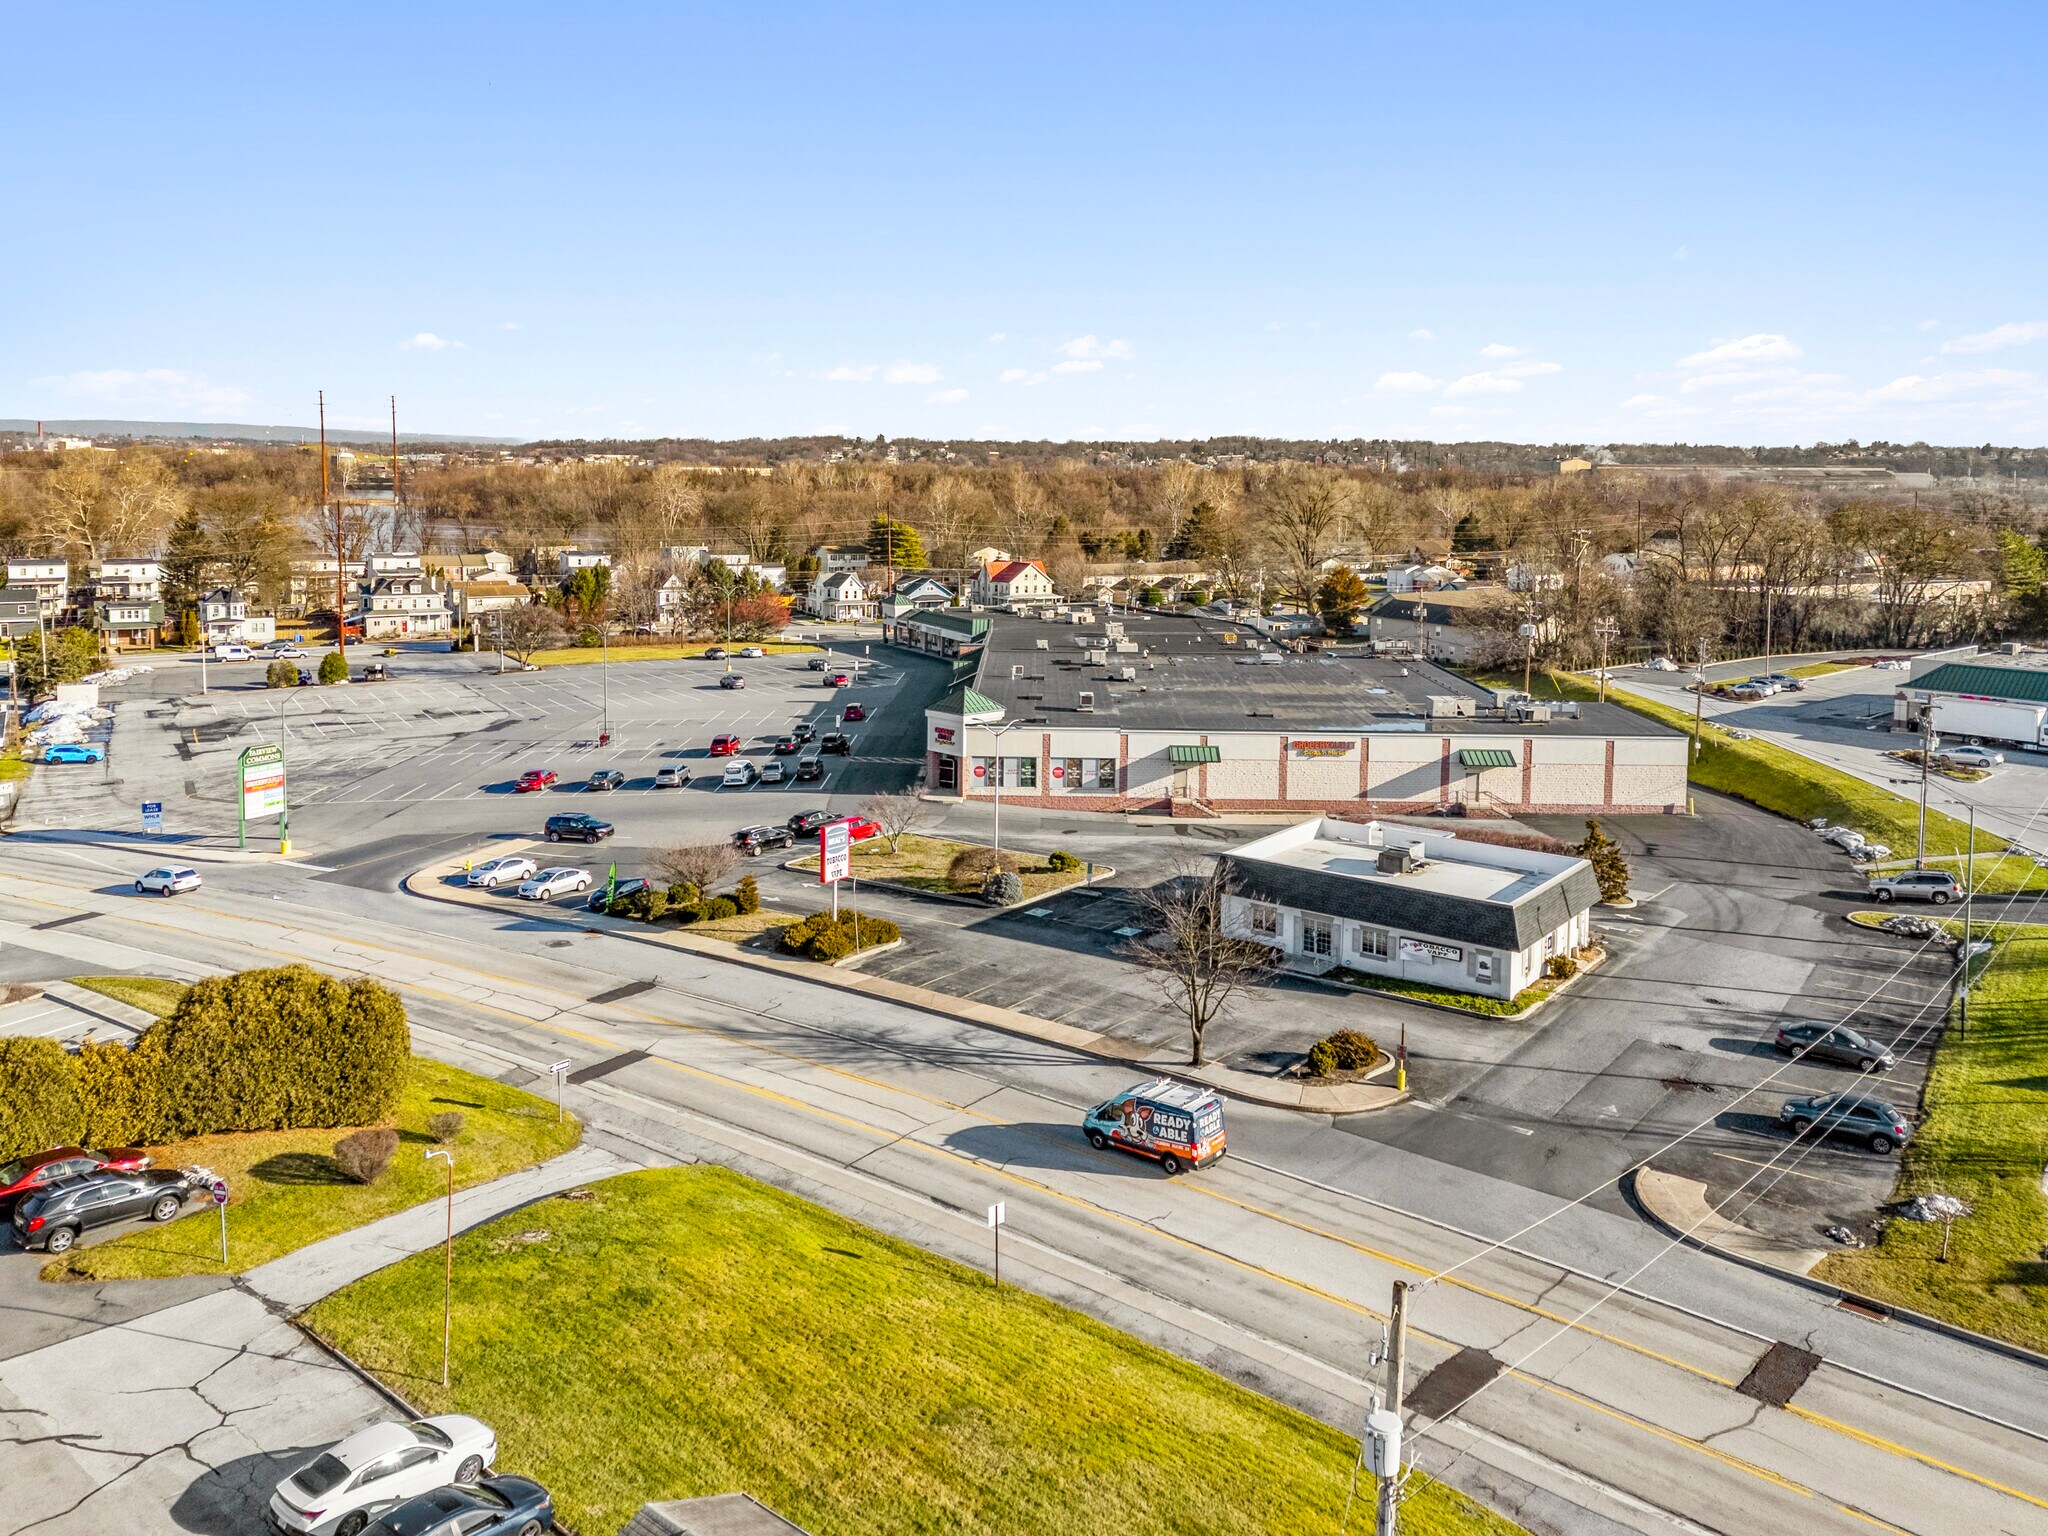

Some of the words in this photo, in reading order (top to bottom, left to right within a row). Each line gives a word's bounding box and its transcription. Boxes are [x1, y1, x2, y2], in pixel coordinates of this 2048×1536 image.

[246, 753, 281, 764] COMMONS
[249, 746, 277, 757] FAIRVIEW
[1419, 942, 1458, 955] TOBACCO
[1153, 1112, 1191, 1130] READY
[1199, 1108, 1221, 1129] READY
[1159, 1126, 1188, 1143] ABLE
[1204, 1119, 1221, 1136] ABLE
